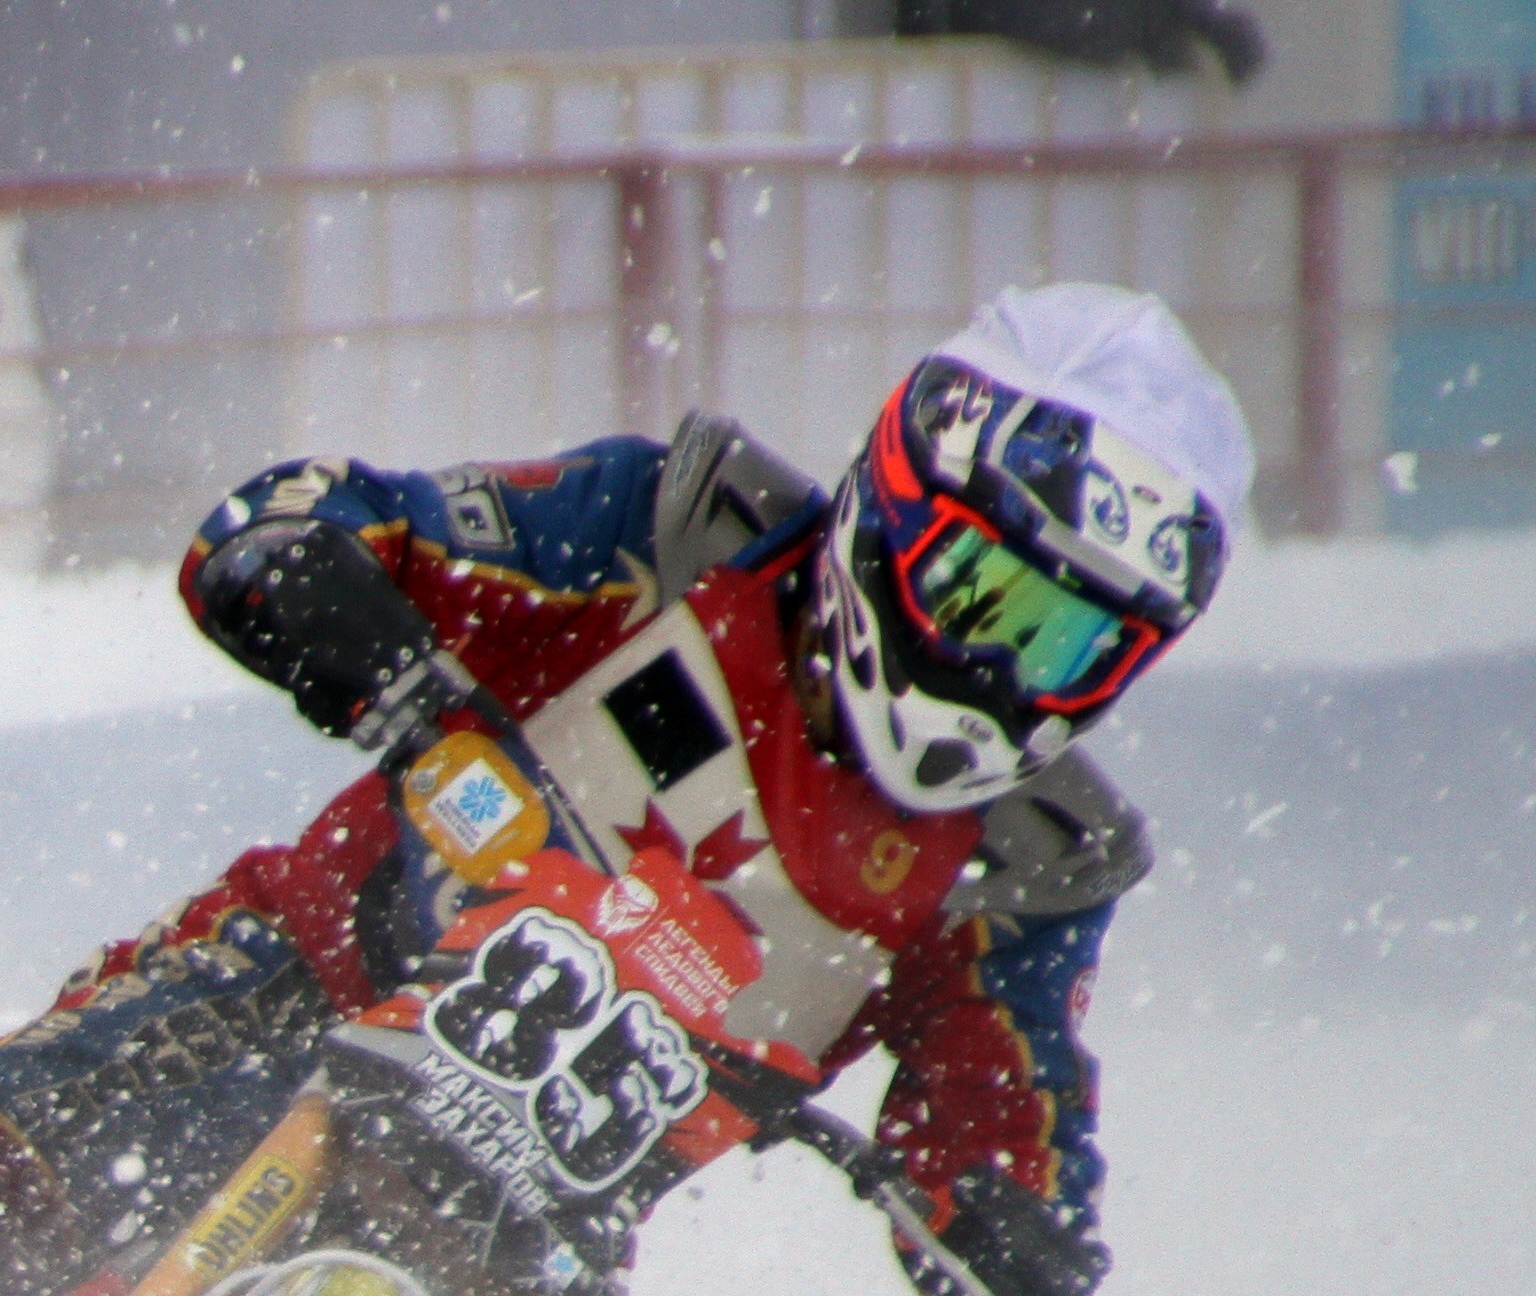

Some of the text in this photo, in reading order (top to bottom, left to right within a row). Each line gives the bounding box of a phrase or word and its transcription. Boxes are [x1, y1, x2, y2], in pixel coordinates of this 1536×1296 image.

[859, 829, 915, 895] 9
[414, 1053, 547, 1168] МАКСИМ
[424, 906, 708, 1195] 85
[416, 1087, 550, 1214] ЗАХАРОВ
